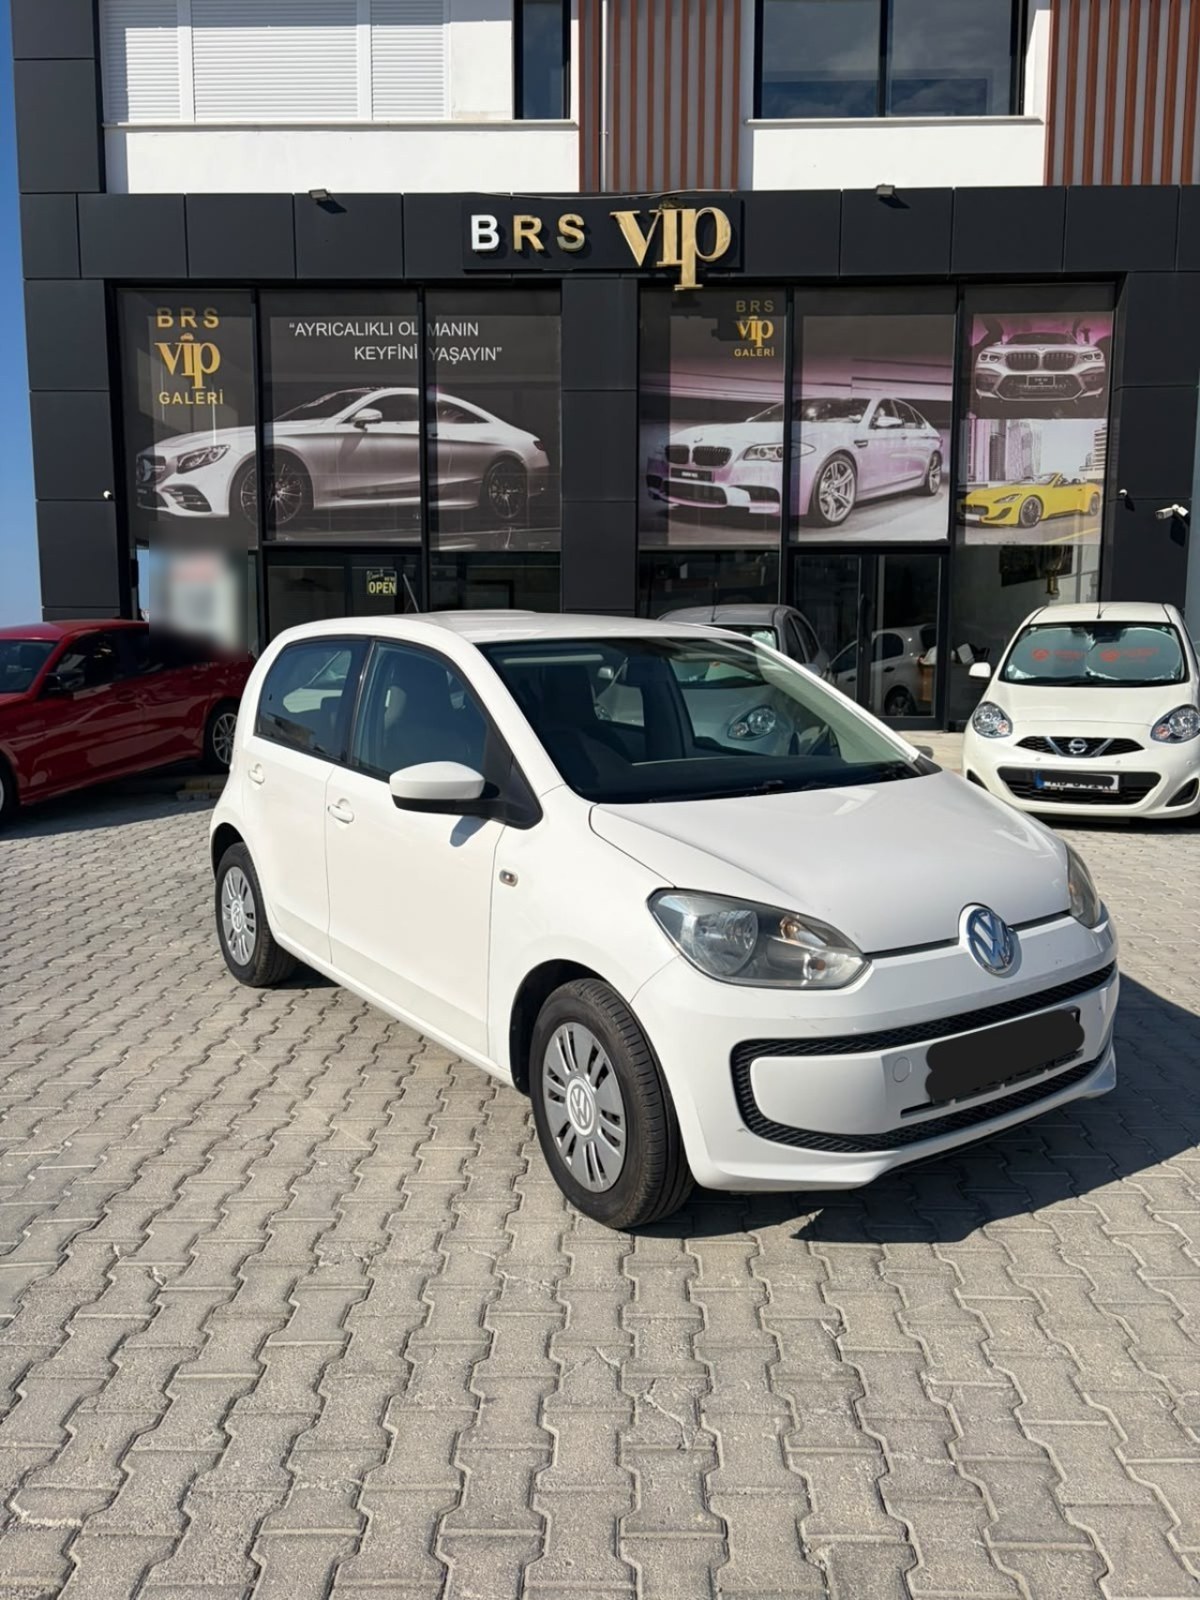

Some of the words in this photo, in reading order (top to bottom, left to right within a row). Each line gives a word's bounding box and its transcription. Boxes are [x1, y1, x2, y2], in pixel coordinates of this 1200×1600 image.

[470, 214, 586, 252] BRS
[735, 300, 774, 313] BRS
[157, 307, 219, 328] BRS
[398, 321, 479, 337] OLMANIN
[354, 344, 418, 360] KEYFİNİ
[734, 346, 775, 357] GALERİ
[159, 389, 224, 405] GALERİ
[369, 581, 397, 594] OPEN
